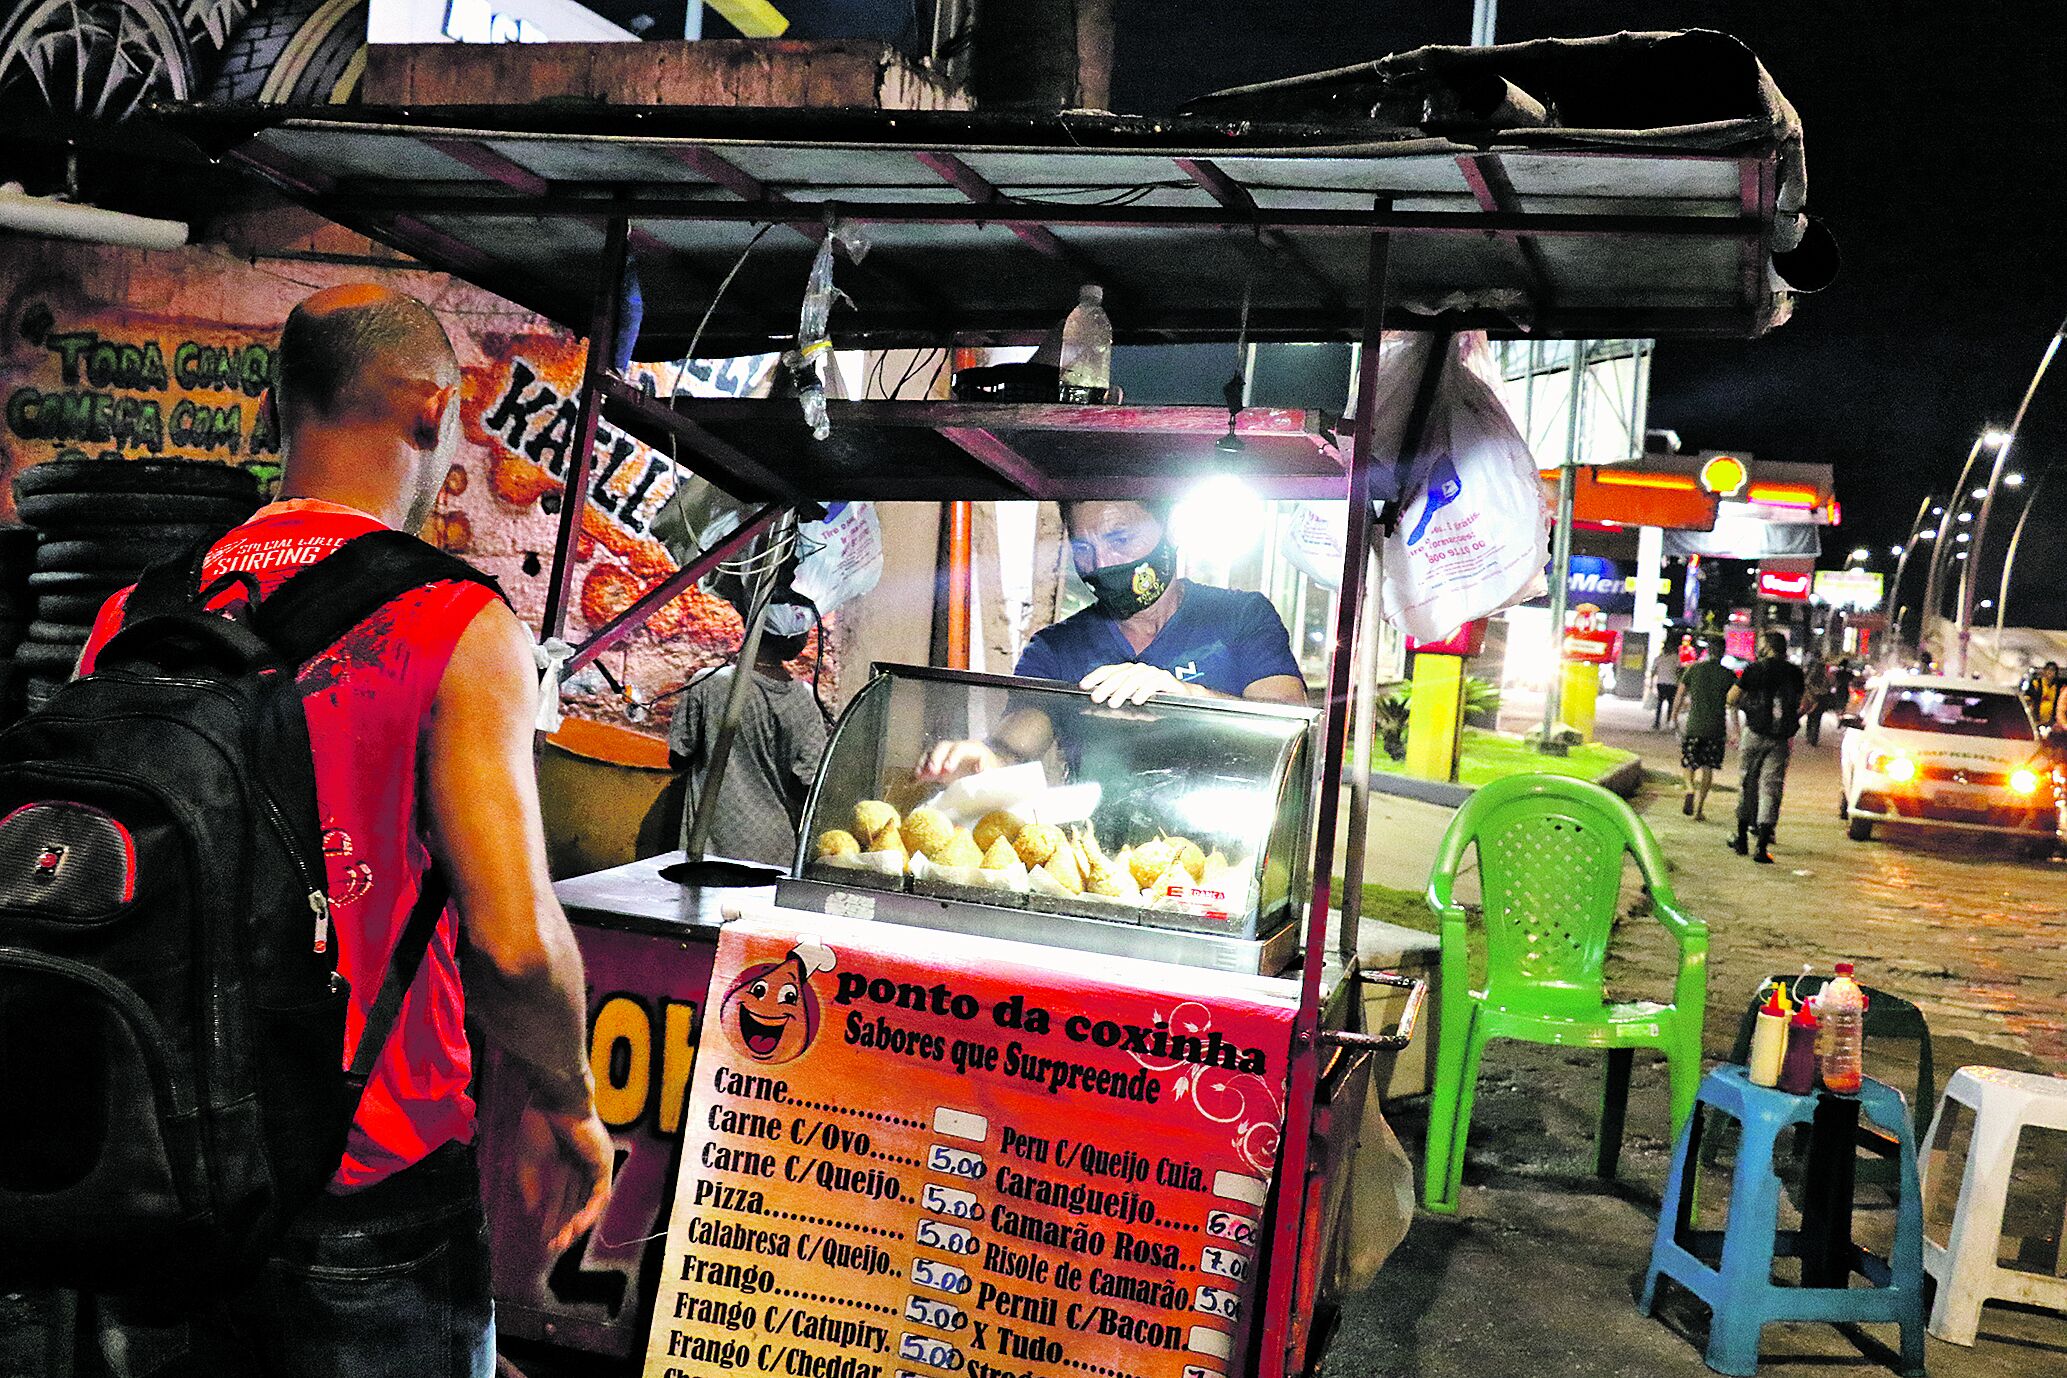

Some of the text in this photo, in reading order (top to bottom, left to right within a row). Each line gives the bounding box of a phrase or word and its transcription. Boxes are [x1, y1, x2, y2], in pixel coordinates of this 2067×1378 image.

[213, 546, 320, 575] SURFING
[833, 971, 1267, 1076] ponto da coxinha
[844, 1010, 1162, 1104] Sabores que Surpreende
[708, 1104, 782, 1140] Carne
[702, 1142, 775, 1178] Carne
[1000, 1126, 1049, 1164] Peru
[1055, 1138, 1149, 1184] C/Queijo
[927, 1187, 985, 1221] 5.00
[689, 1216, 789, 1257] Calabresa
[918, 1220, 980, 1255] 5.00
[991, 1204, 1105, 1256] Camarão
[914, 1259, 972, 1295] 5.00
[983, 1241, 1049, 1285] Risole
[1055, 1261, 1082, 1293] de
[674, 1292, 756, 1330] Frango
[909, 1297, 968, 1331] 5.00
[976, 1281, 1057, 1327] Pernil
[667, 1330, 750, 1368] Frango
[903, 1335, 965, 1371] 5.00
[970, 1320, 989, 1350] X
